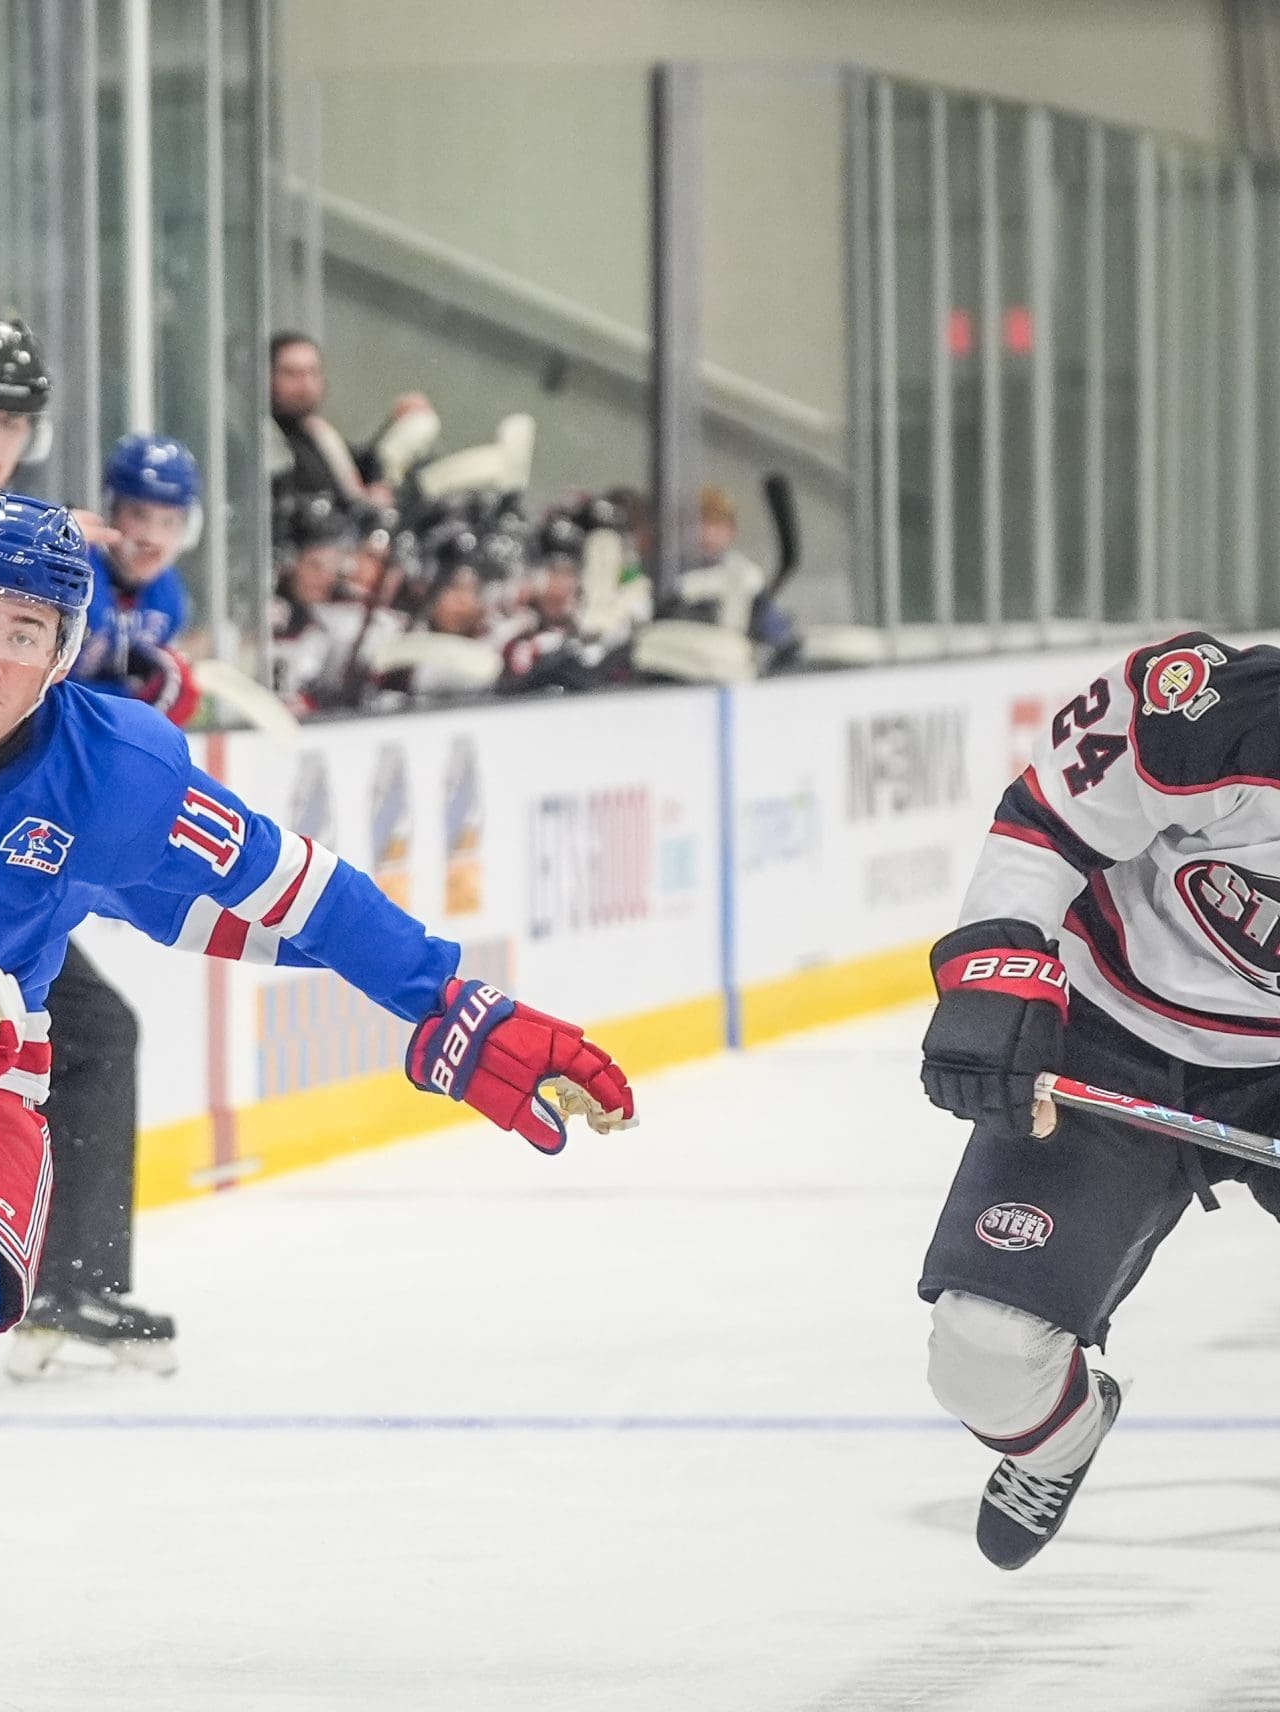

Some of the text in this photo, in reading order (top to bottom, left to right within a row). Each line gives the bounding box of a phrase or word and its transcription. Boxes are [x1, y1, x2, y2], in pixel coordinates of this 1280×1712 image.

[1051, 677, 1128, 797] 24
[168, 786, 245, 877] 11
[960, 956, 1070, 1005] BAU
[431, 983, 507, 1095] BAUE
[984, 1208, 1046, 1243] STEEL
